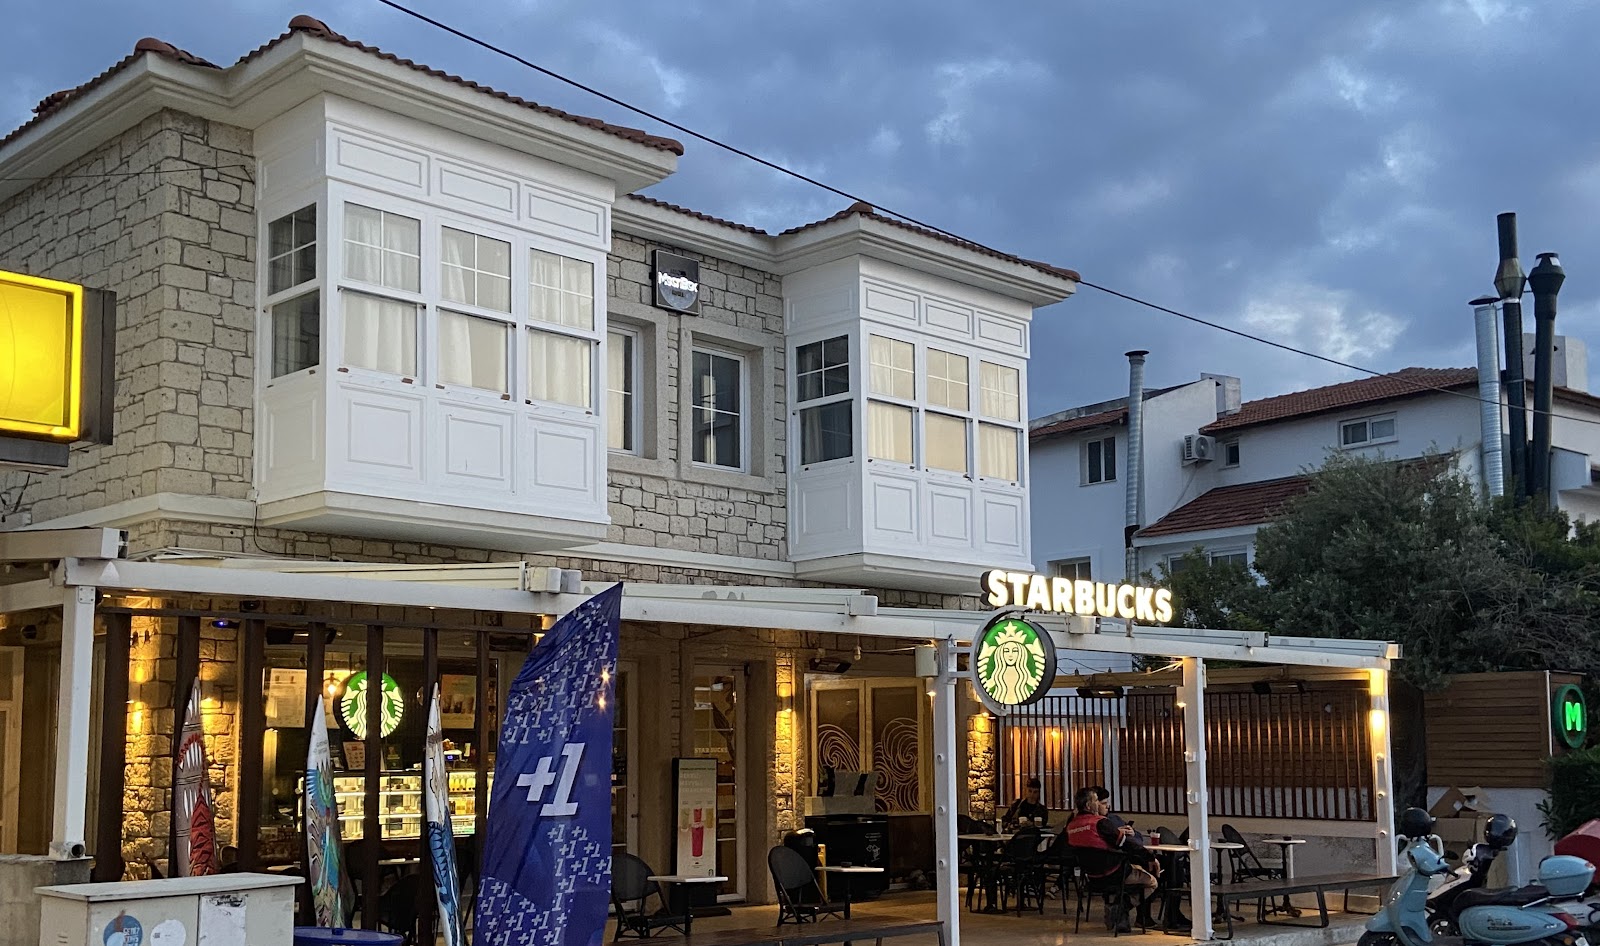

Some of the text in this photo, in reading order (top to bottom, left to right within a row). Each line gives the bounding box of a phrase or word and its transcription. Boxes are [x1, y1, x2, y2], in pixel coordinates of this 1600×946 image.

[987, 570, 1173, 622] STARBUCKS
[595, 642, 609, 659] +1
[1566, 701, 1581, 731] M
[516, 742, 586, 817] +1
[548, 824, 565, 842] +1
[559, 840, 576, 858] +1
[571, 857, 588, 875] +1
[596, 856, 612, 874] +1
[558, 875, 576, 893] +1
[506, 912, 524, 931] +1
[532, 911, 549, 930] +1
[544, 927, 561, 945] +1
